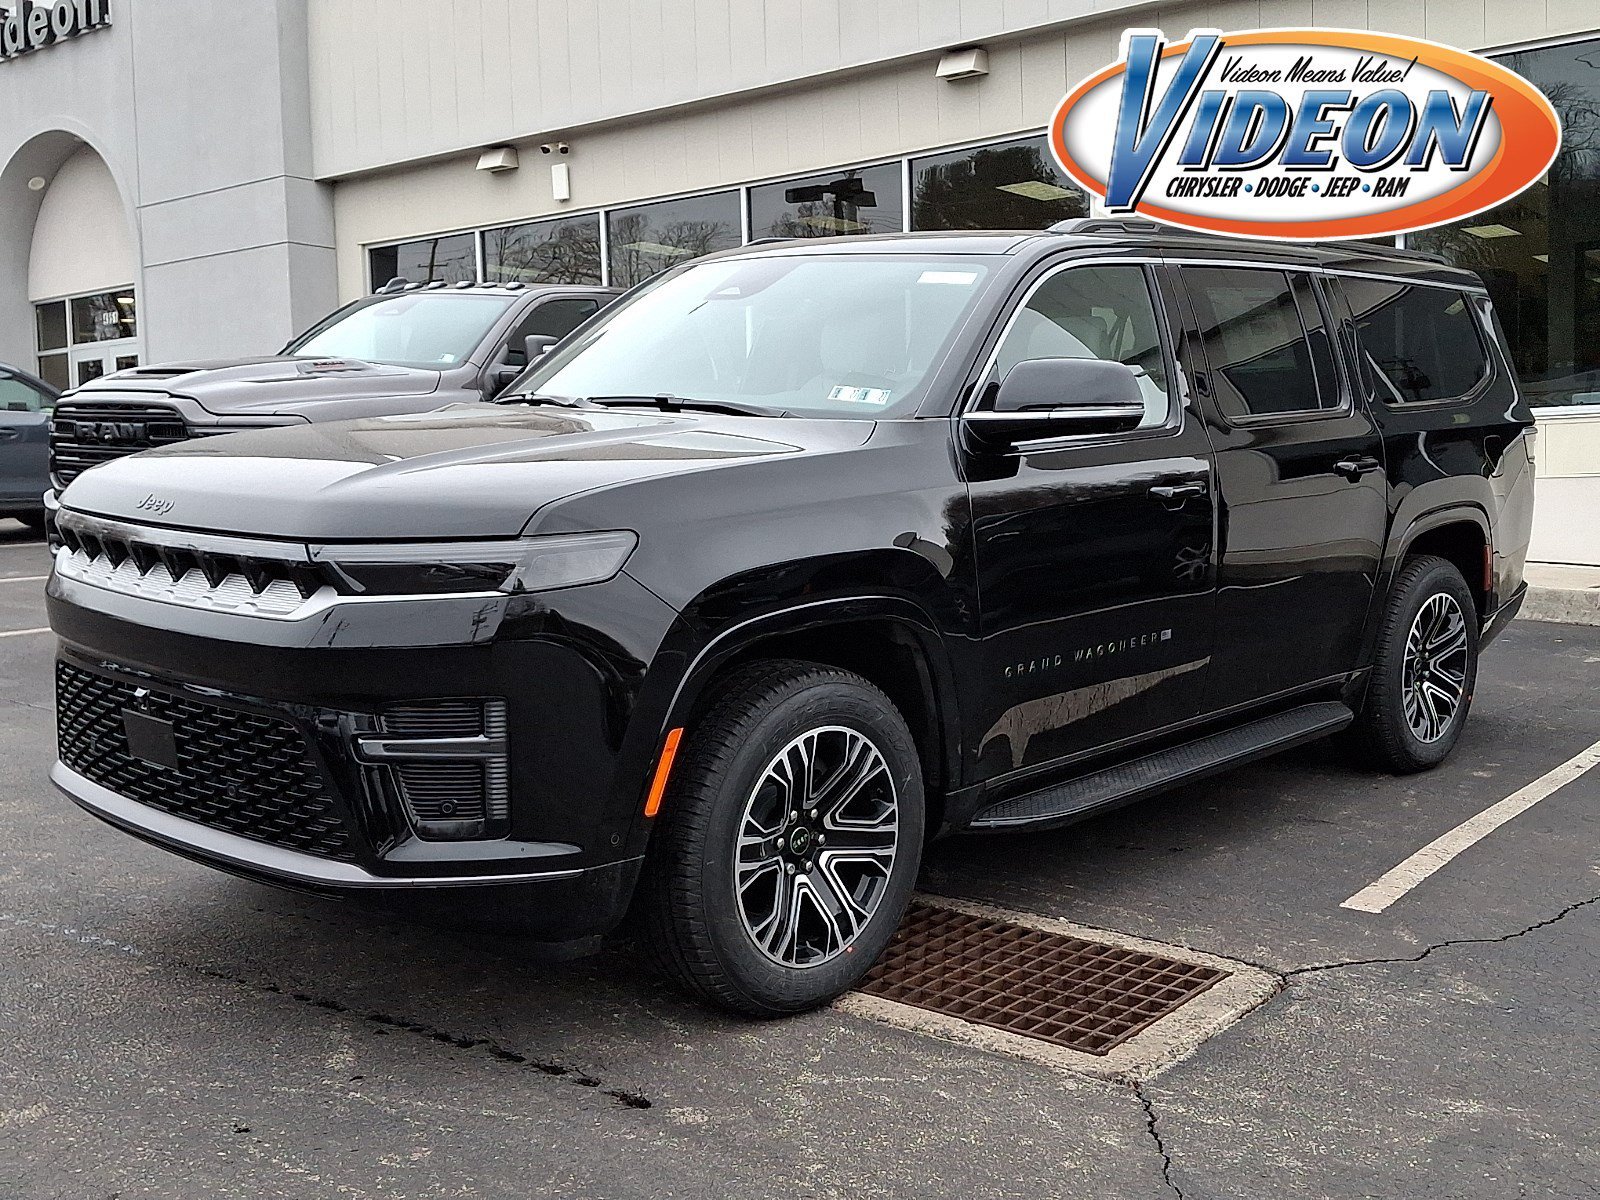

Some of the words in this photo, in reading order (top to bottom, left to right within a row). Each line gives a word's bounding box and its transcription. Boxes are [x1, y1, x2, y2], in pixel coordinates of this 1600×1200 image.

[0, 0, 100, 54] deon
[75, 420, 147, 440] RAM
[136, 492, 175, 516] Jeep
[1004, 654, 1062, 678] GRAND
[1074, 632, 1158, 662] WAGONEER
